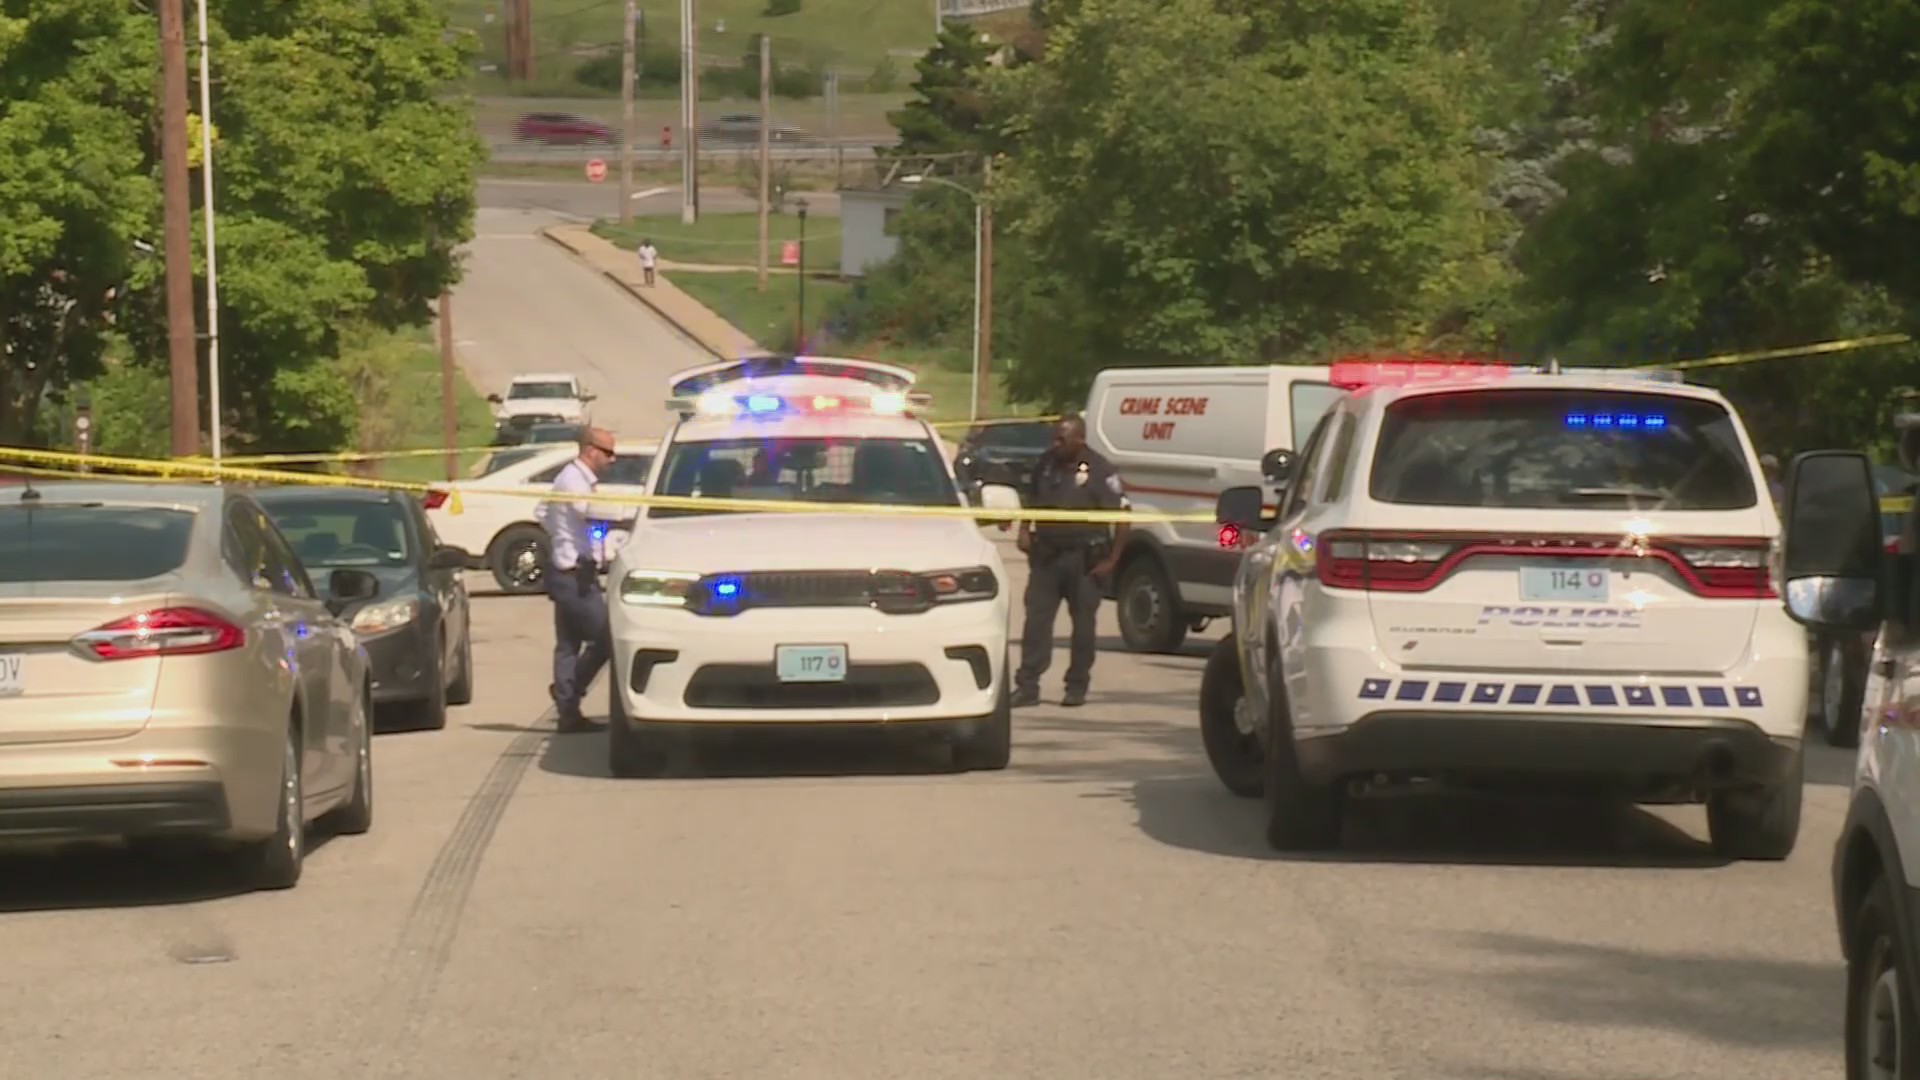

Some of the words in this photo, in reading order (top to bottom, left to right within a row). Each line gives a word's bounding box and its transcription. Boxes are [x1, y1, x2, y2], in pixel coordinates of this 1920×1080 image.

[1120, 397, 1161, 415] CRIME
[1164, 397, 1209, 415] SCENE
[1142, 422, 1176, 440] UNIT
[1552, 571, 1581, 590] 114
[801, 656, 824, 671] 117
